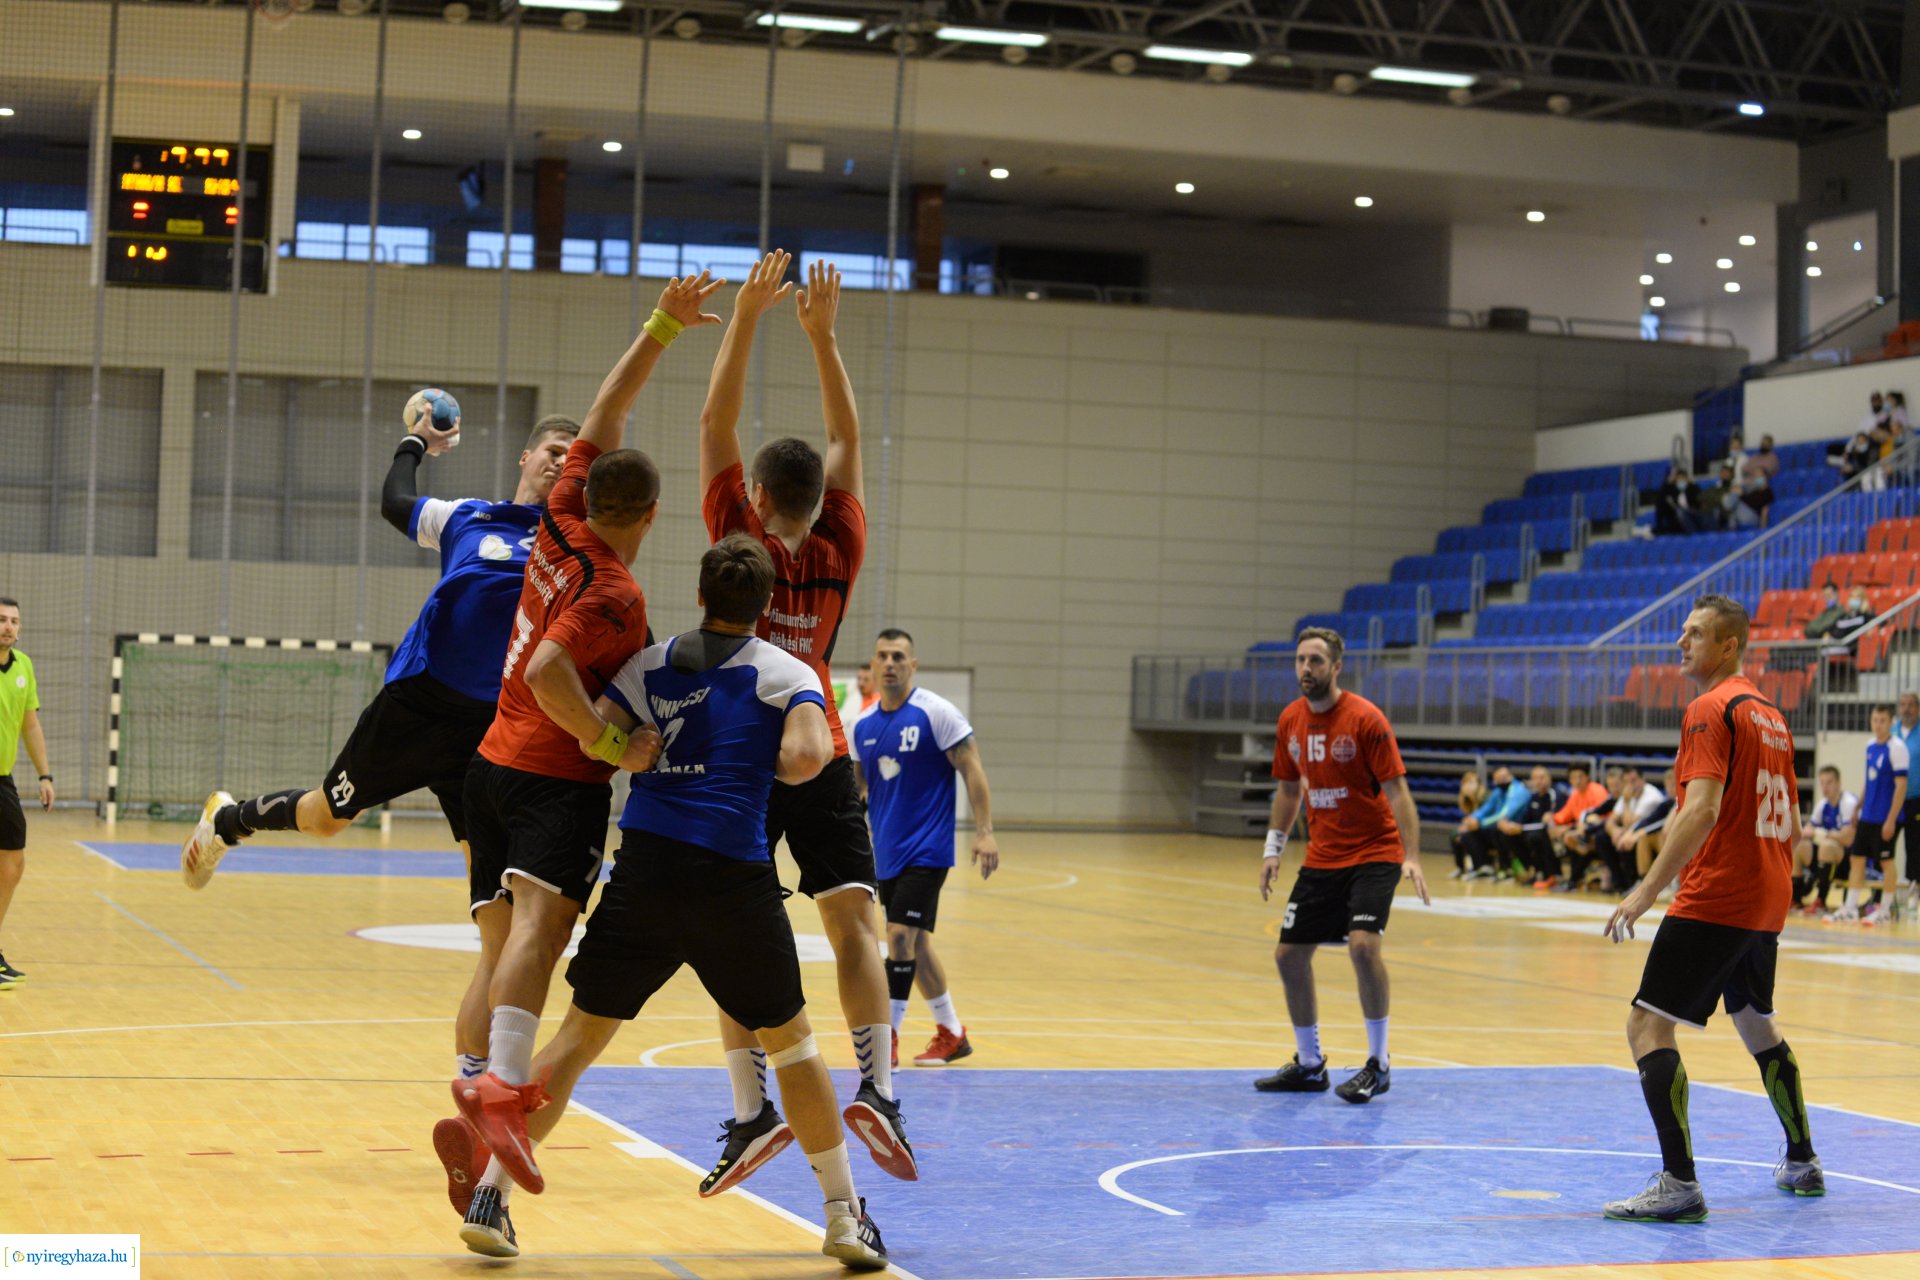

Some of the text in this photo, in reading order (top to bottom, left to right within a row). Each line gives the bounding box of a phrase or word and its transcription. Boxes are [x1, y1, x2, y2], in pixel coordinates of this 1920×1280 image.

[472, 511, 491, 520] JAKO
[899, 725, 919, 752] 19
[1307, 733, 1327, 762] 15
[331, 770, 355, 807] 29
[1755, 768, 1793, 843] 28
[585, 845, 603, 884] 7
